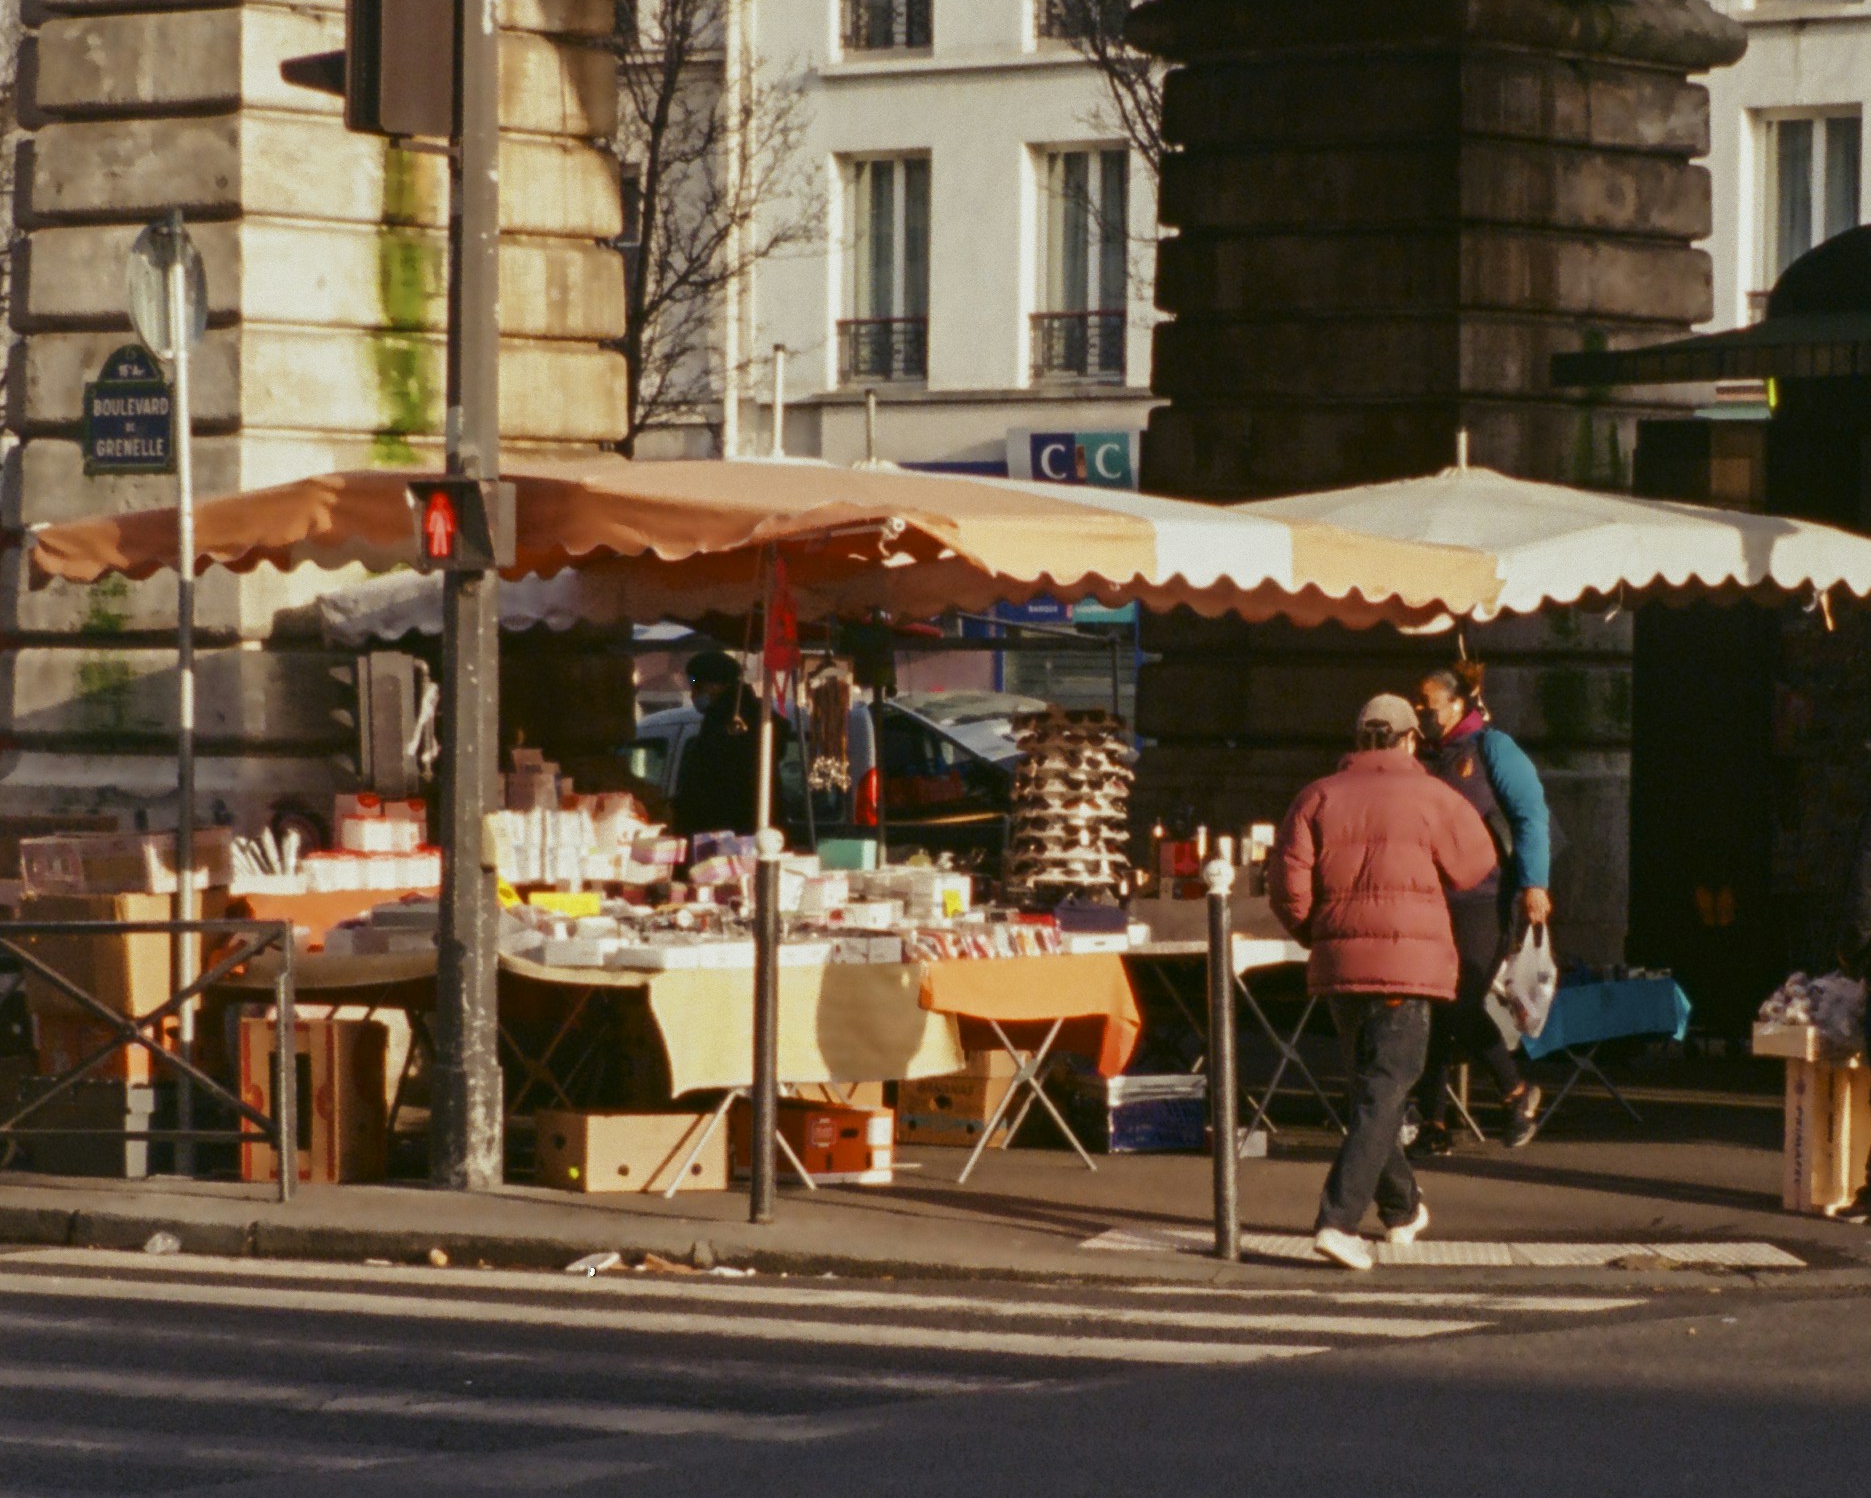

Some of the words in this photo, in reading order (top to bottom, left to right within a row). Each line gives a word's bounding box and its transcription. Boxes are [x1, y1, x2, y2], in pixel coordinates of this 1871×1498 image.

[93, 397, 169, 417] BOULEVARD
[96, 438, 165, 458] GRENELLE
[1040, 443, 1123, 480] CIC
